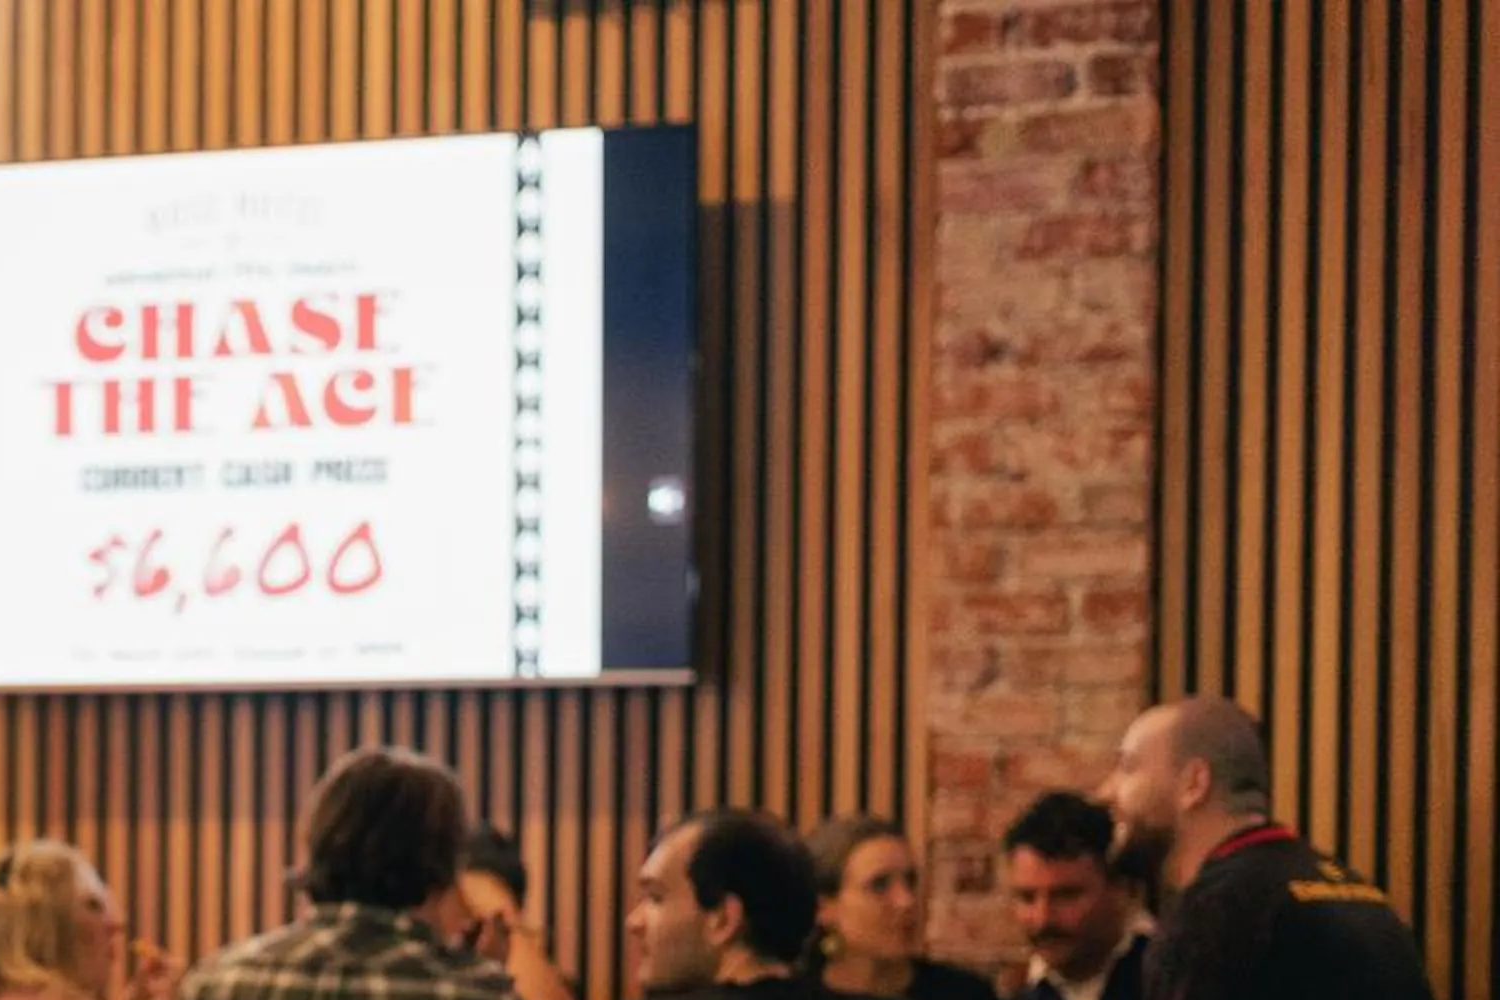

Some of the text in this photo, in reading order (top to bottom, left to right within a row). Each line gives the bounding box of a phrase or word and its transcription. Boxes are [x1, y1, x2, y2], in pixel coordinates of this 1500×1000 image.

[75, 293, 402, 363] CHASE
[38, 365, 438, 437] THE ACE
[88, 520, 383, 615] $6,600
